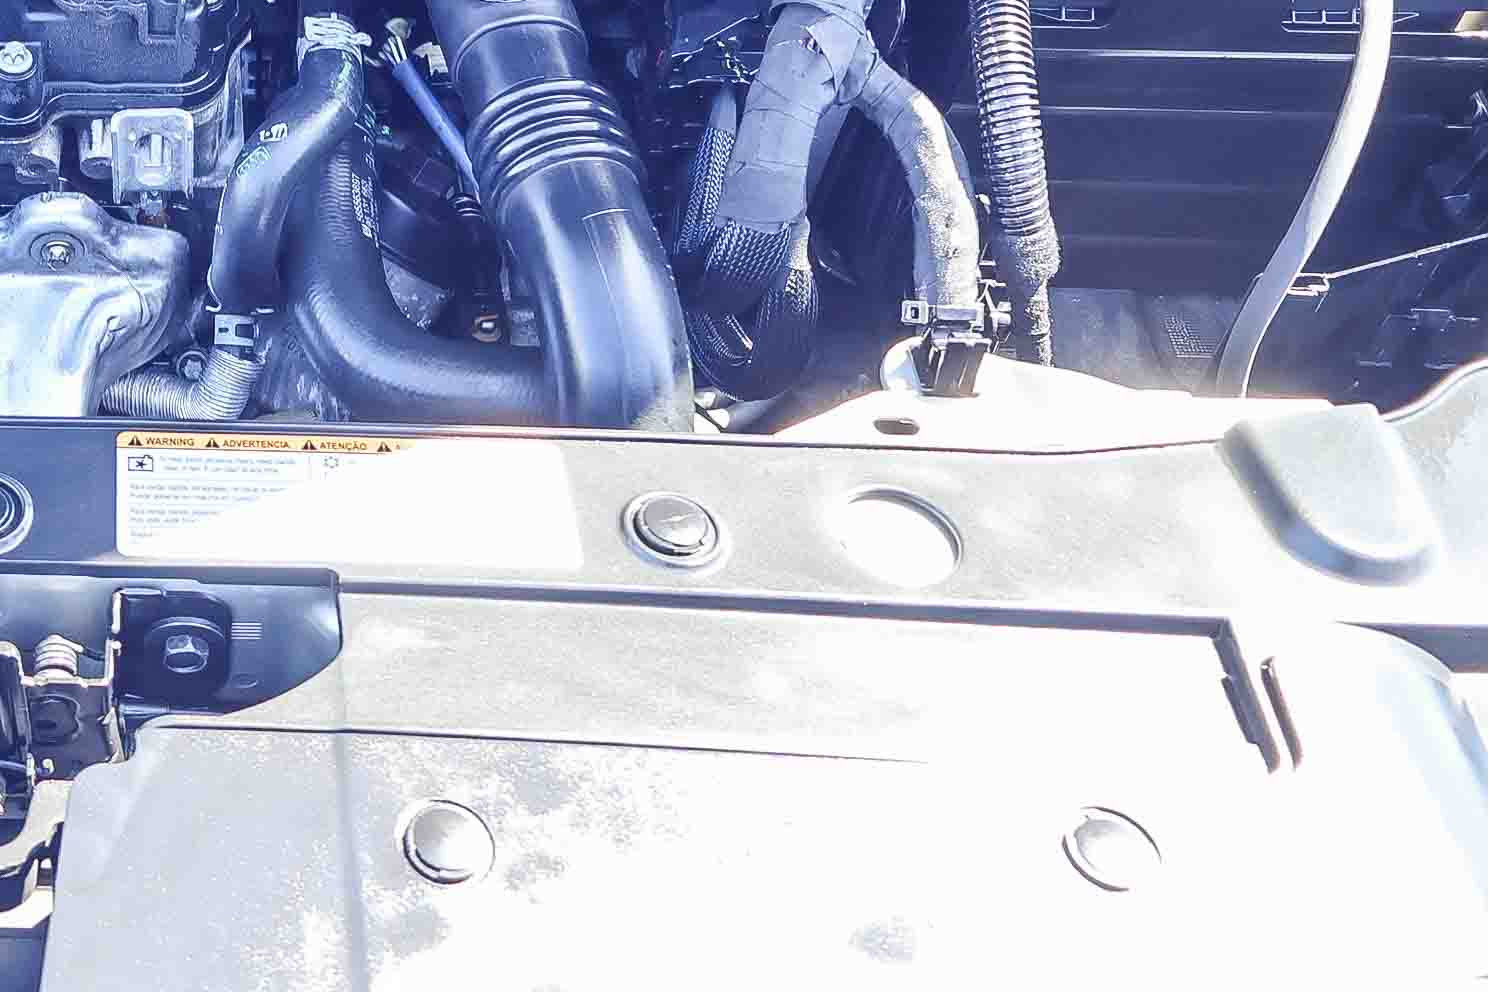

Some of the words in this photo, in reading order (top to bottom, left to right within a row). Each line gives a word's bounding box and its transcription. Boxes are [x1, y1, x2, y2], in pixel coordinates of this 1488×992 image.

[145, 436, 196, 448] WARNING
[222, 439, 291, 450] ADVERTENCIA
[319, 440, 369, 453] ATENÇÃO
